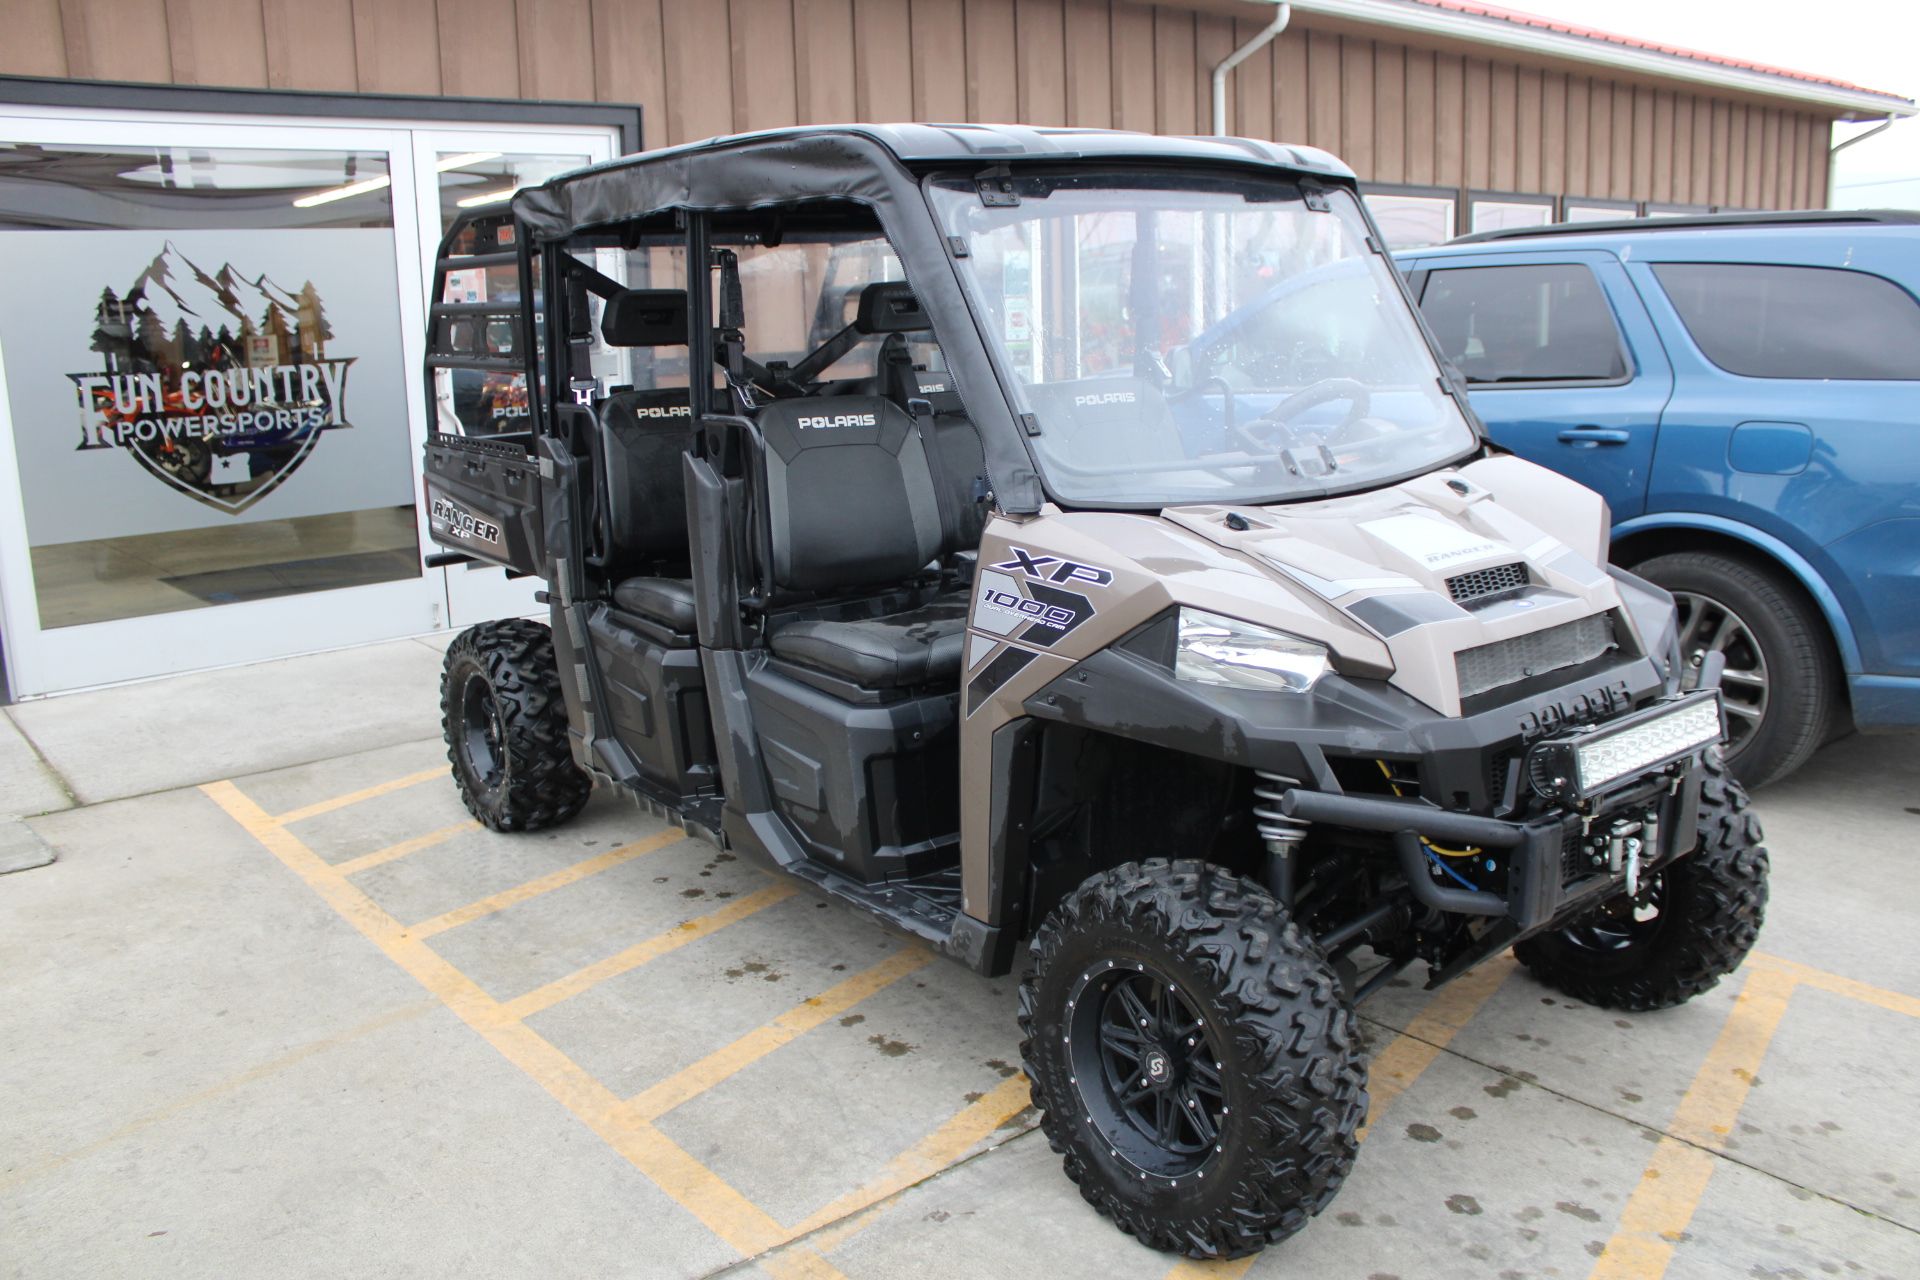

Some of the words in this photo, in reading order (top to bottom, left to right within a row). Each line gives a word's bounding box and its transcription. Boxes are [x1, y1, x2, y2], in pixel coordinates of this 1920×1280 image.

[78, 371, 165, 446] FUN
[181, 361, 347, 426] COUNTRY
[636, 406, 692, 419] POLAR
[1075, 392, 1136, 407] POLARIS
[117, 407, 324, 443] POWERSPORTS
[798, 414, 876, 429] POLARIS
[432, 499, 499, 544] RANGER
[451, 525, 470, 539] XP
[988, 545, 1114, 588] XP
[984, 588, 1076, 625] 1000
[1046, 621, 1066, 631] CAM
[1517, 679, 1632, 746] POLARIS
